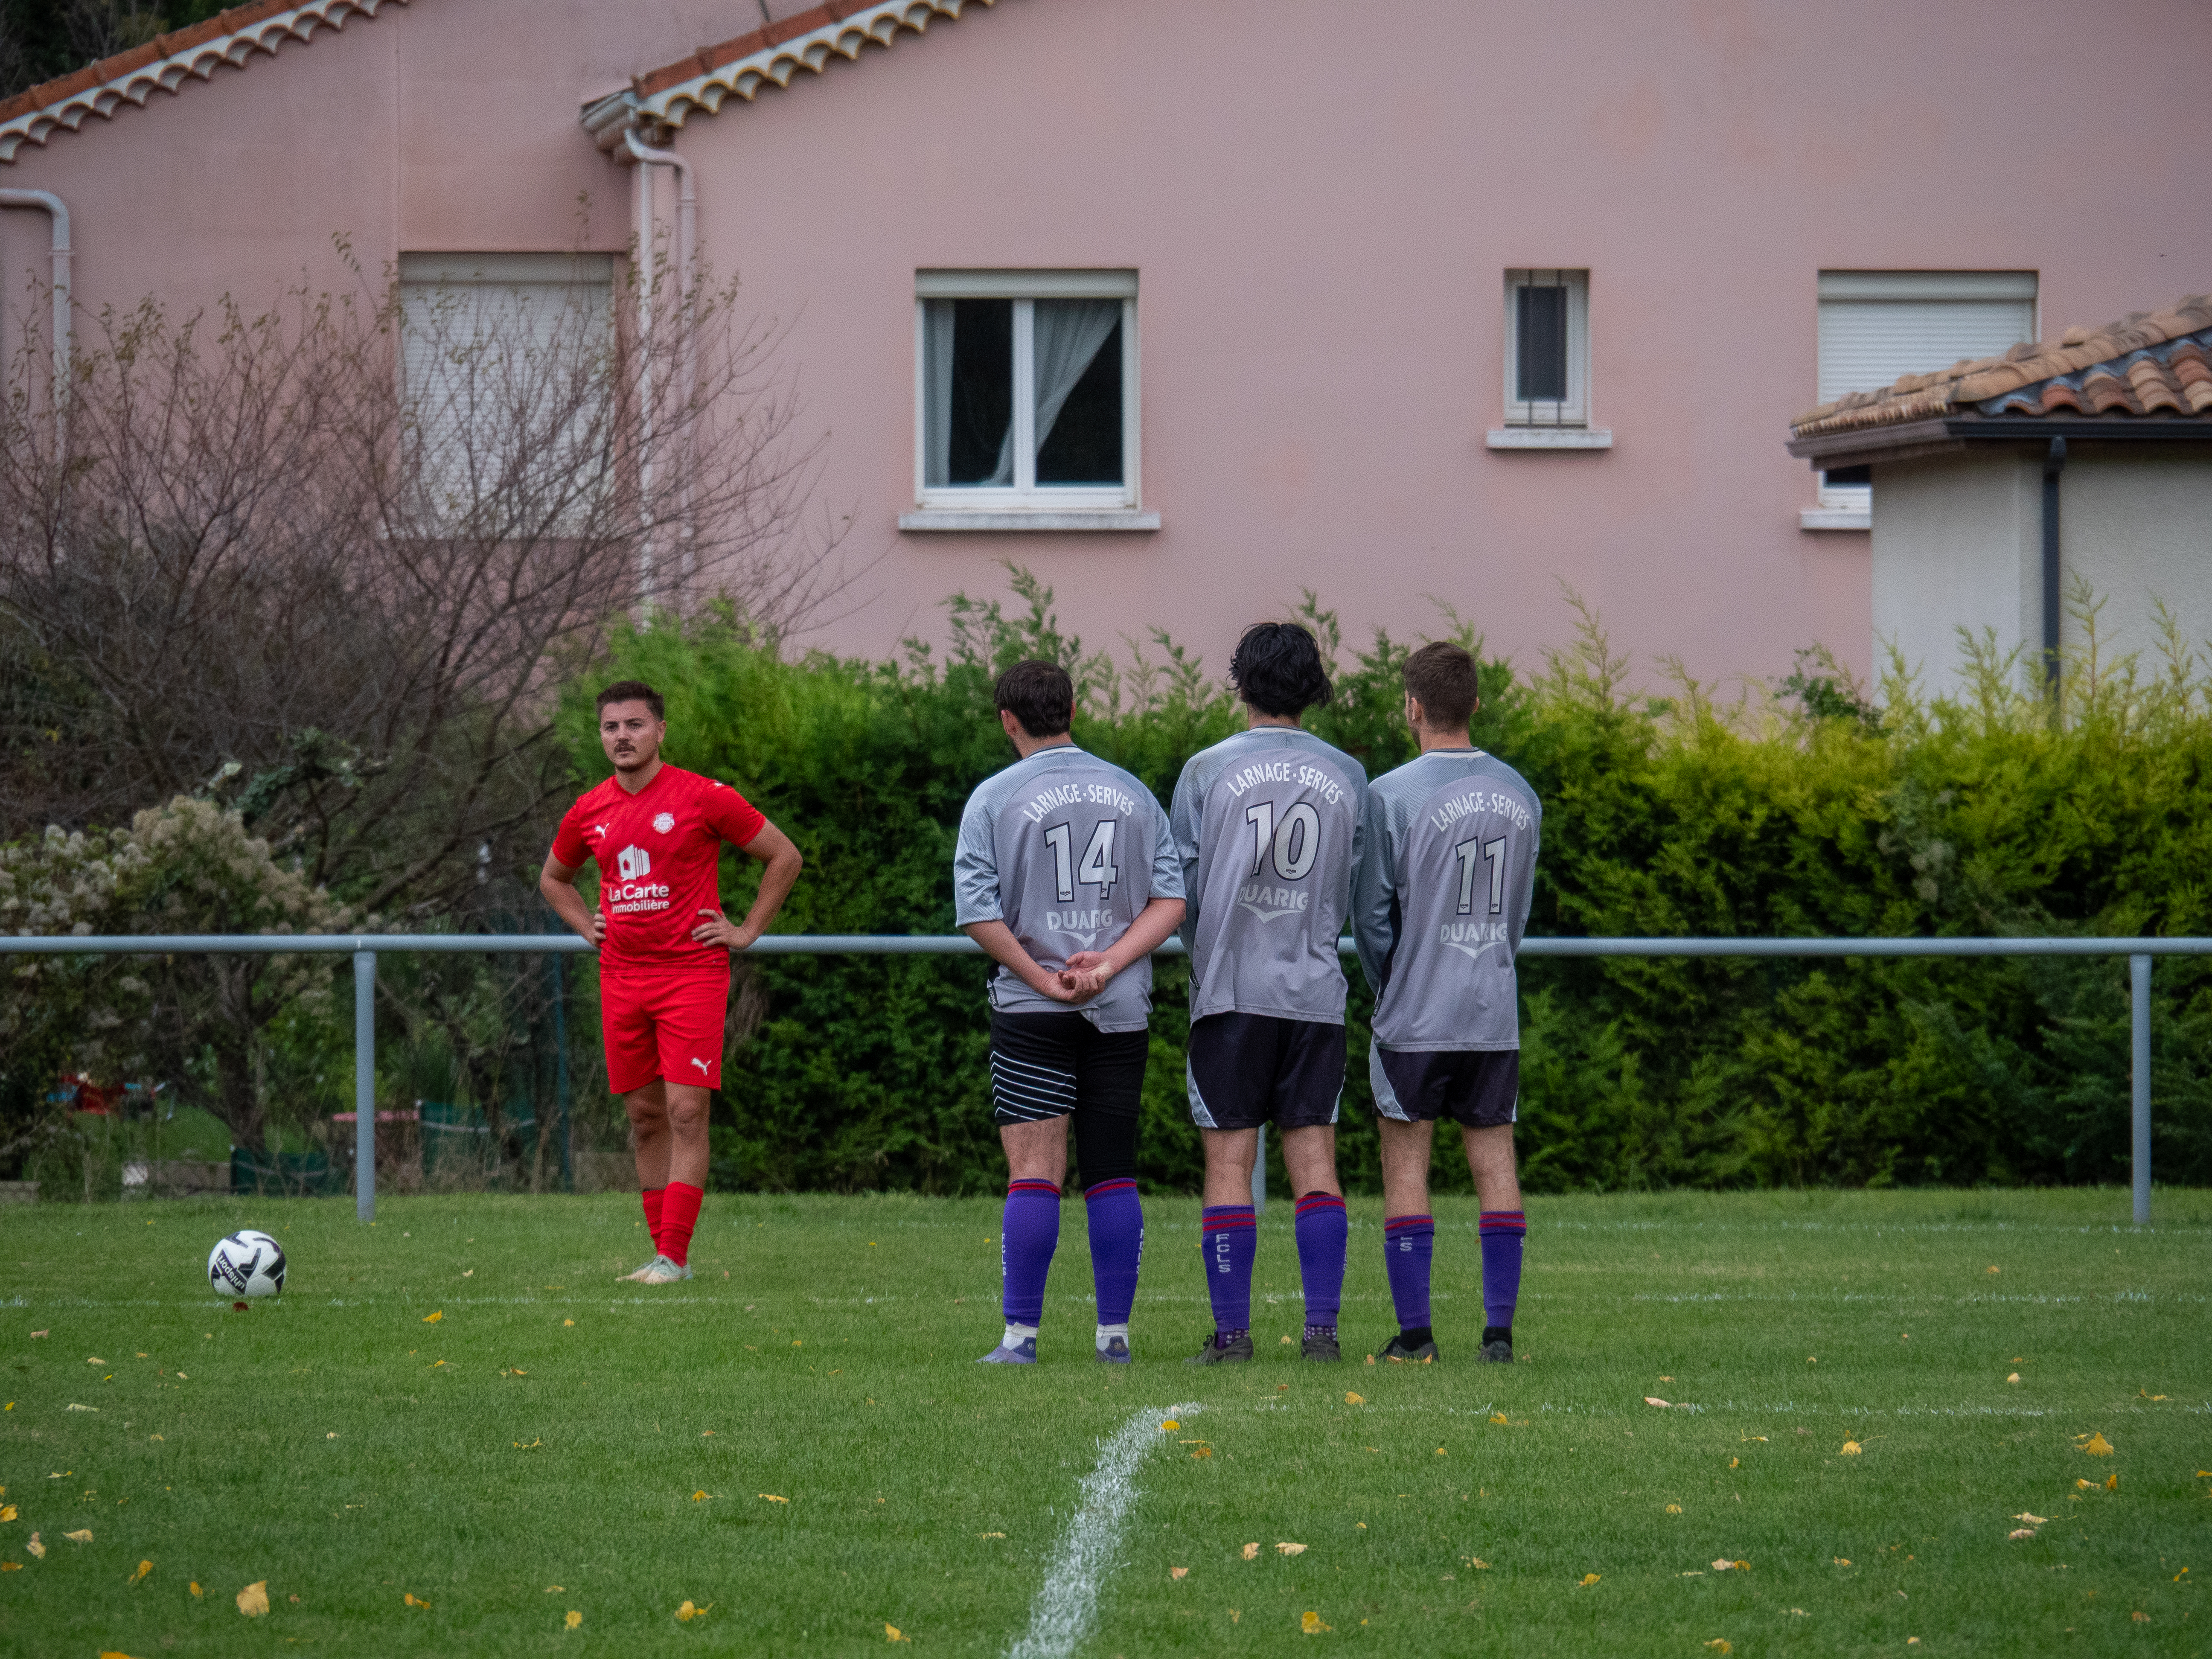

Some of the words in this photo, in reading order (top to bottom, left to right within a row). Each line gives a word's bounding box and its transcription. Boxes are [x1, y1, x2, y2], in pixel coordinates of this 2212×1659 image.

[1246, 800, 1321, 881] 10
[1044, 819, 1118, 903] 14
[1455, 835, 1506, 915] 11
[609, 887, 621, 902] La
[623, 884, 669, 899] Carte
[612, 899, 669, 914] immobilière
[1440, 923, 1508, 943] DUARIG
[1216, 1233, 1231, 1272] FCLS
[217, 1255, 245, 1289] uhlsport
